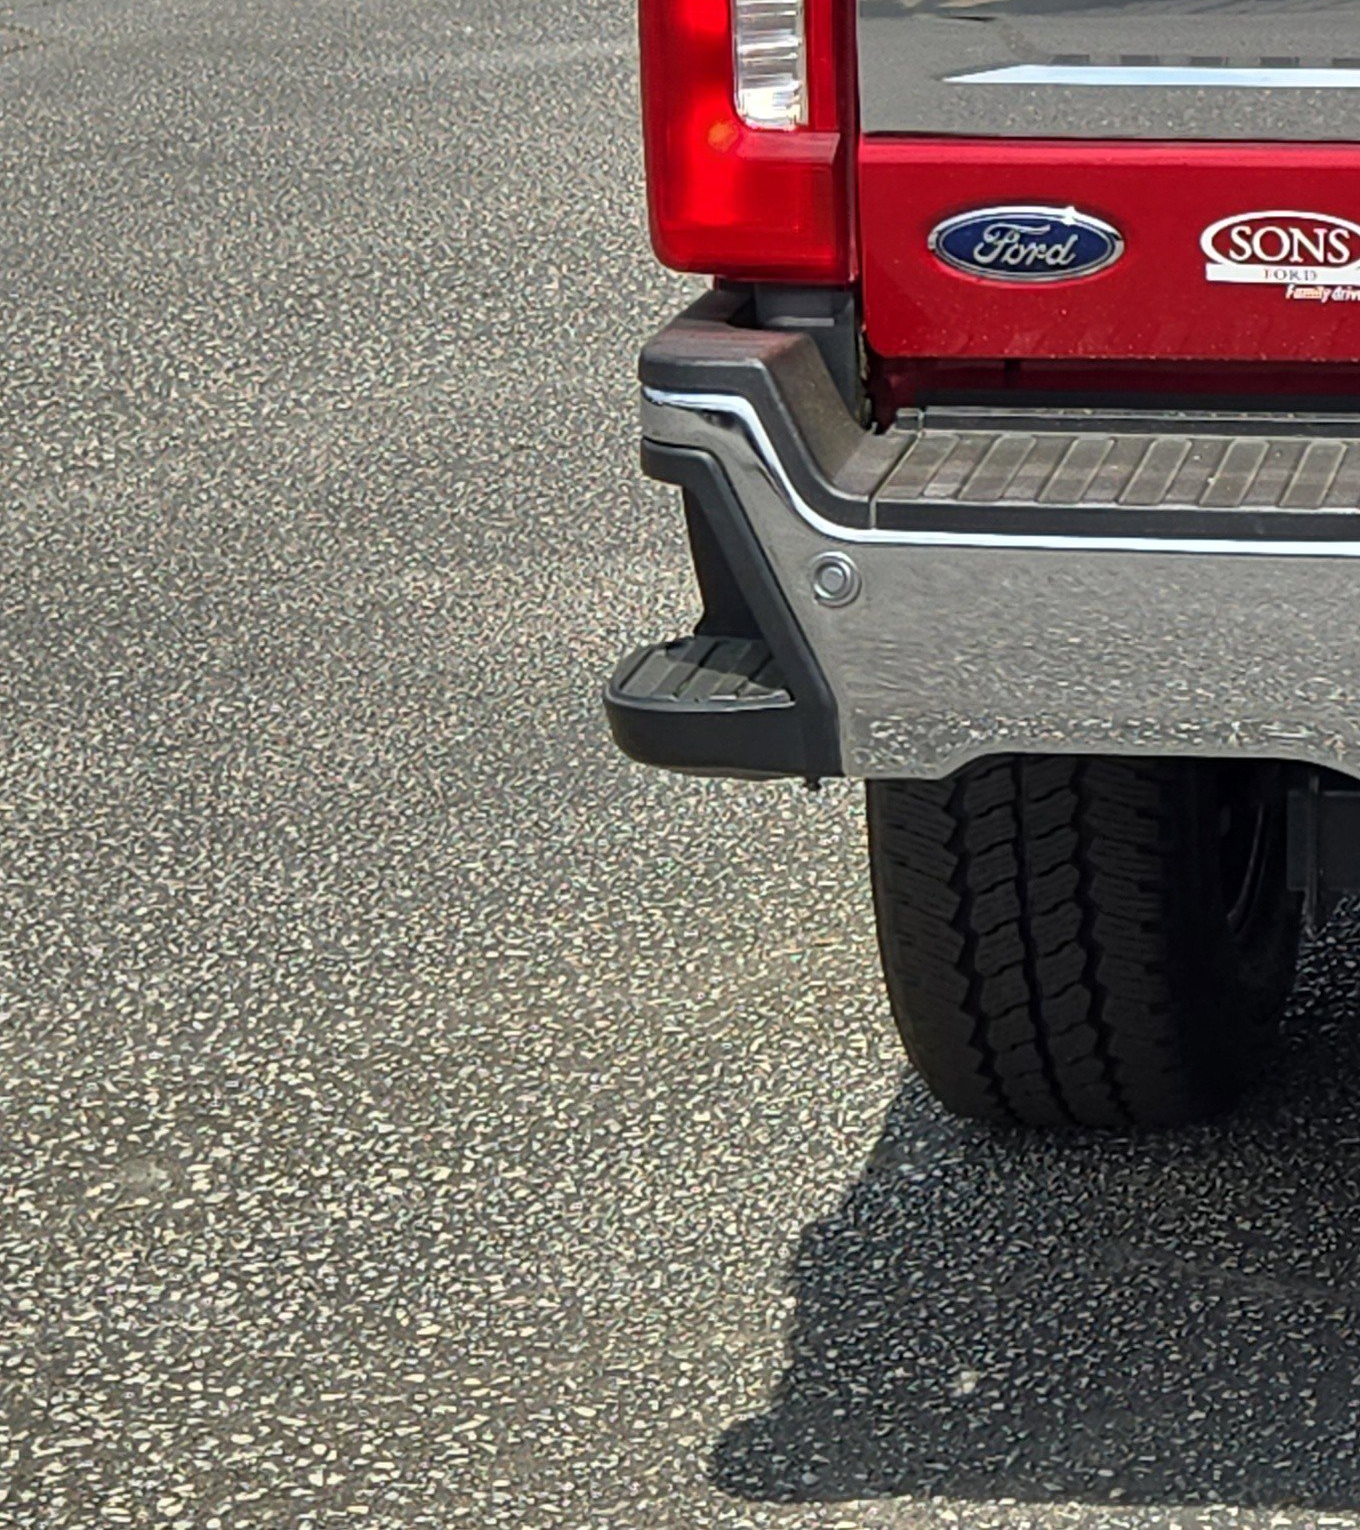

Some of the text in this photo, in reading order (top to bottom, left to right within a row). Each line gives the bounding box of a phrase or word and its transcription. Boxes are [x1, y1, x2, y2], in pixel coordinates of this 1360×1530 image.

[973, 223, 1079, 266] Ford
[1229, 225, 1351, 264] SONS
[1263, 268, 1318, 282] FORD
[1285, 283, 1332, 303] Family
